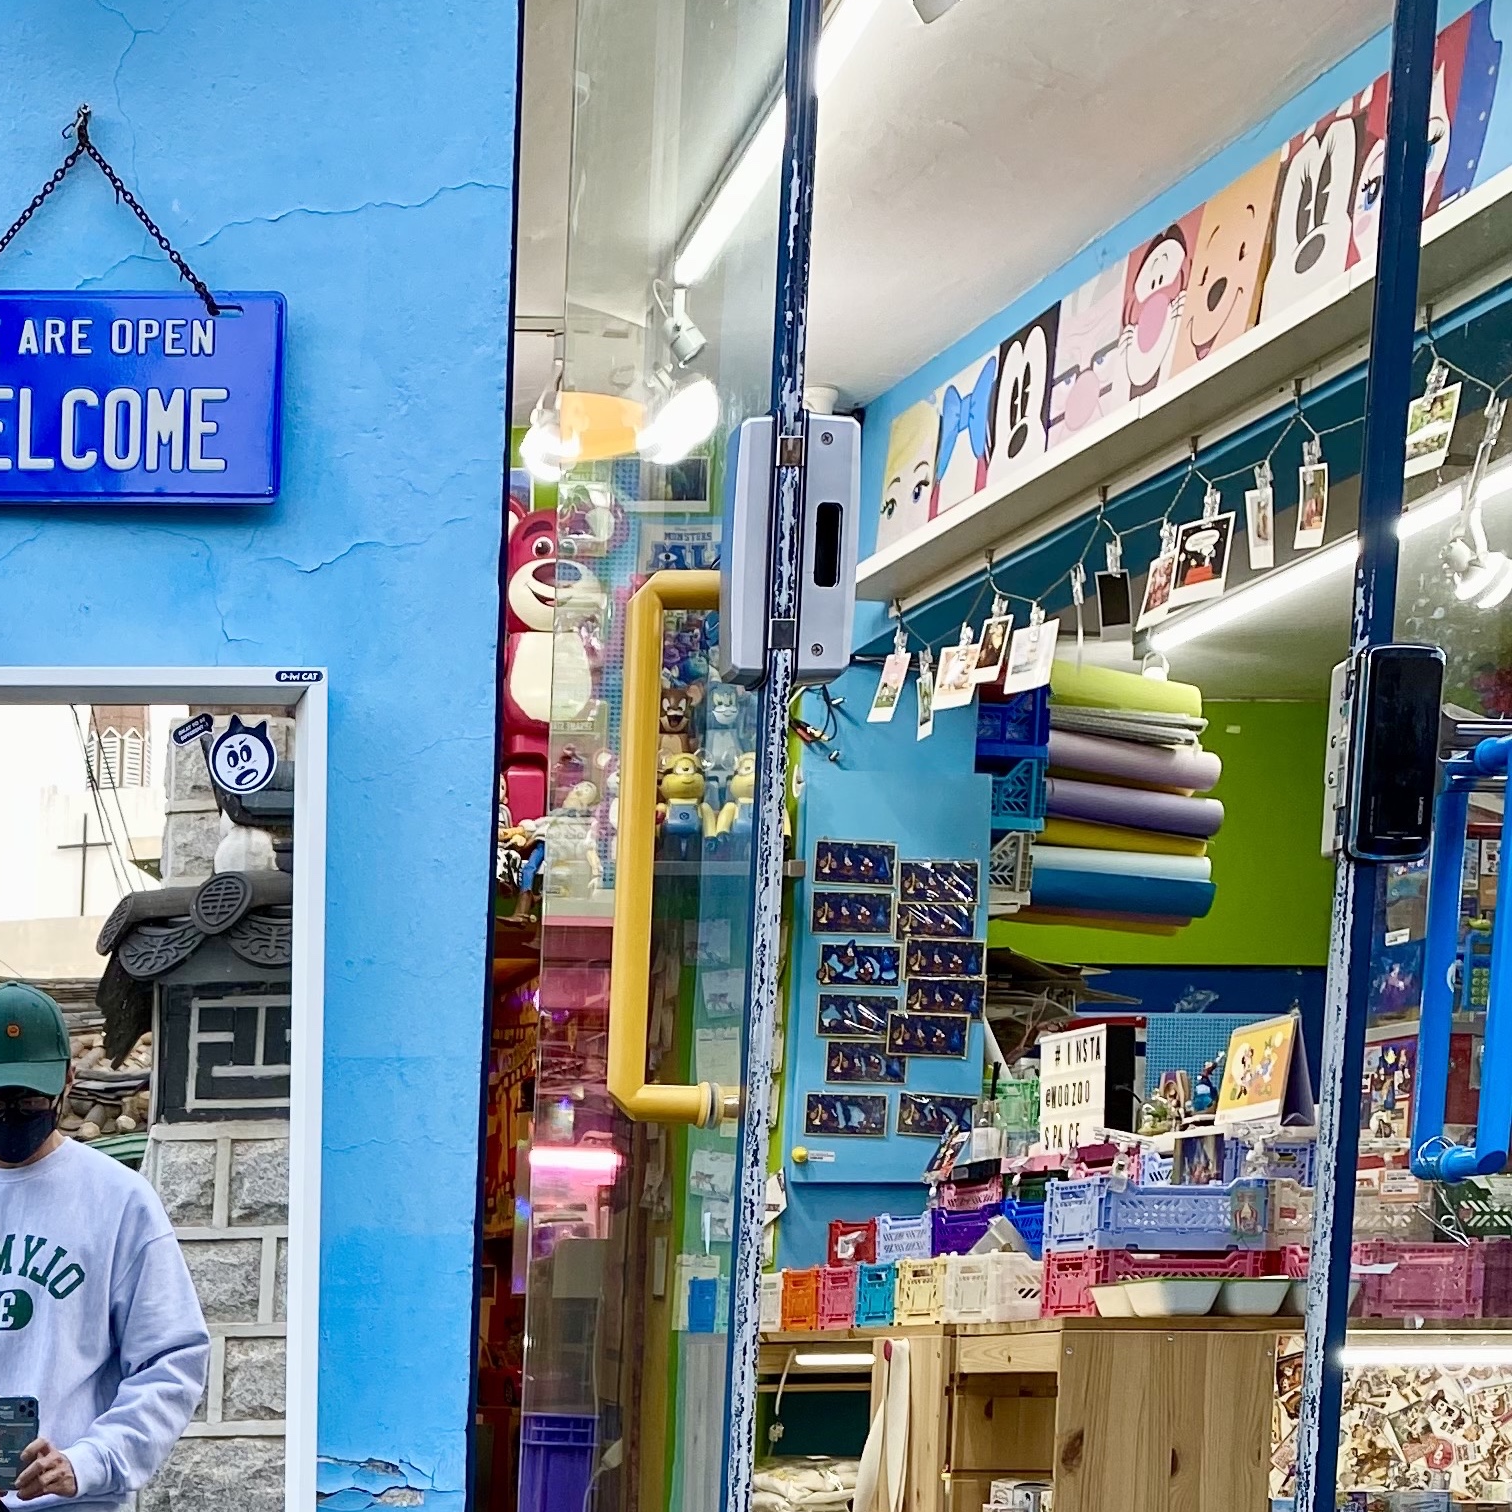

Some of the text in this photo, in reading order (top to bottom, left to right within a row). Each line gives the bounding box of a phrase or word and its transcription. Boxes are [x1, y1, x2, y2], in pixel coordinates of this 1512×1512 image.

[18, 318, 94, 355] ARE
[111, 318, 215, 355] OPEN
[301, 672, 318, 681] CAT
